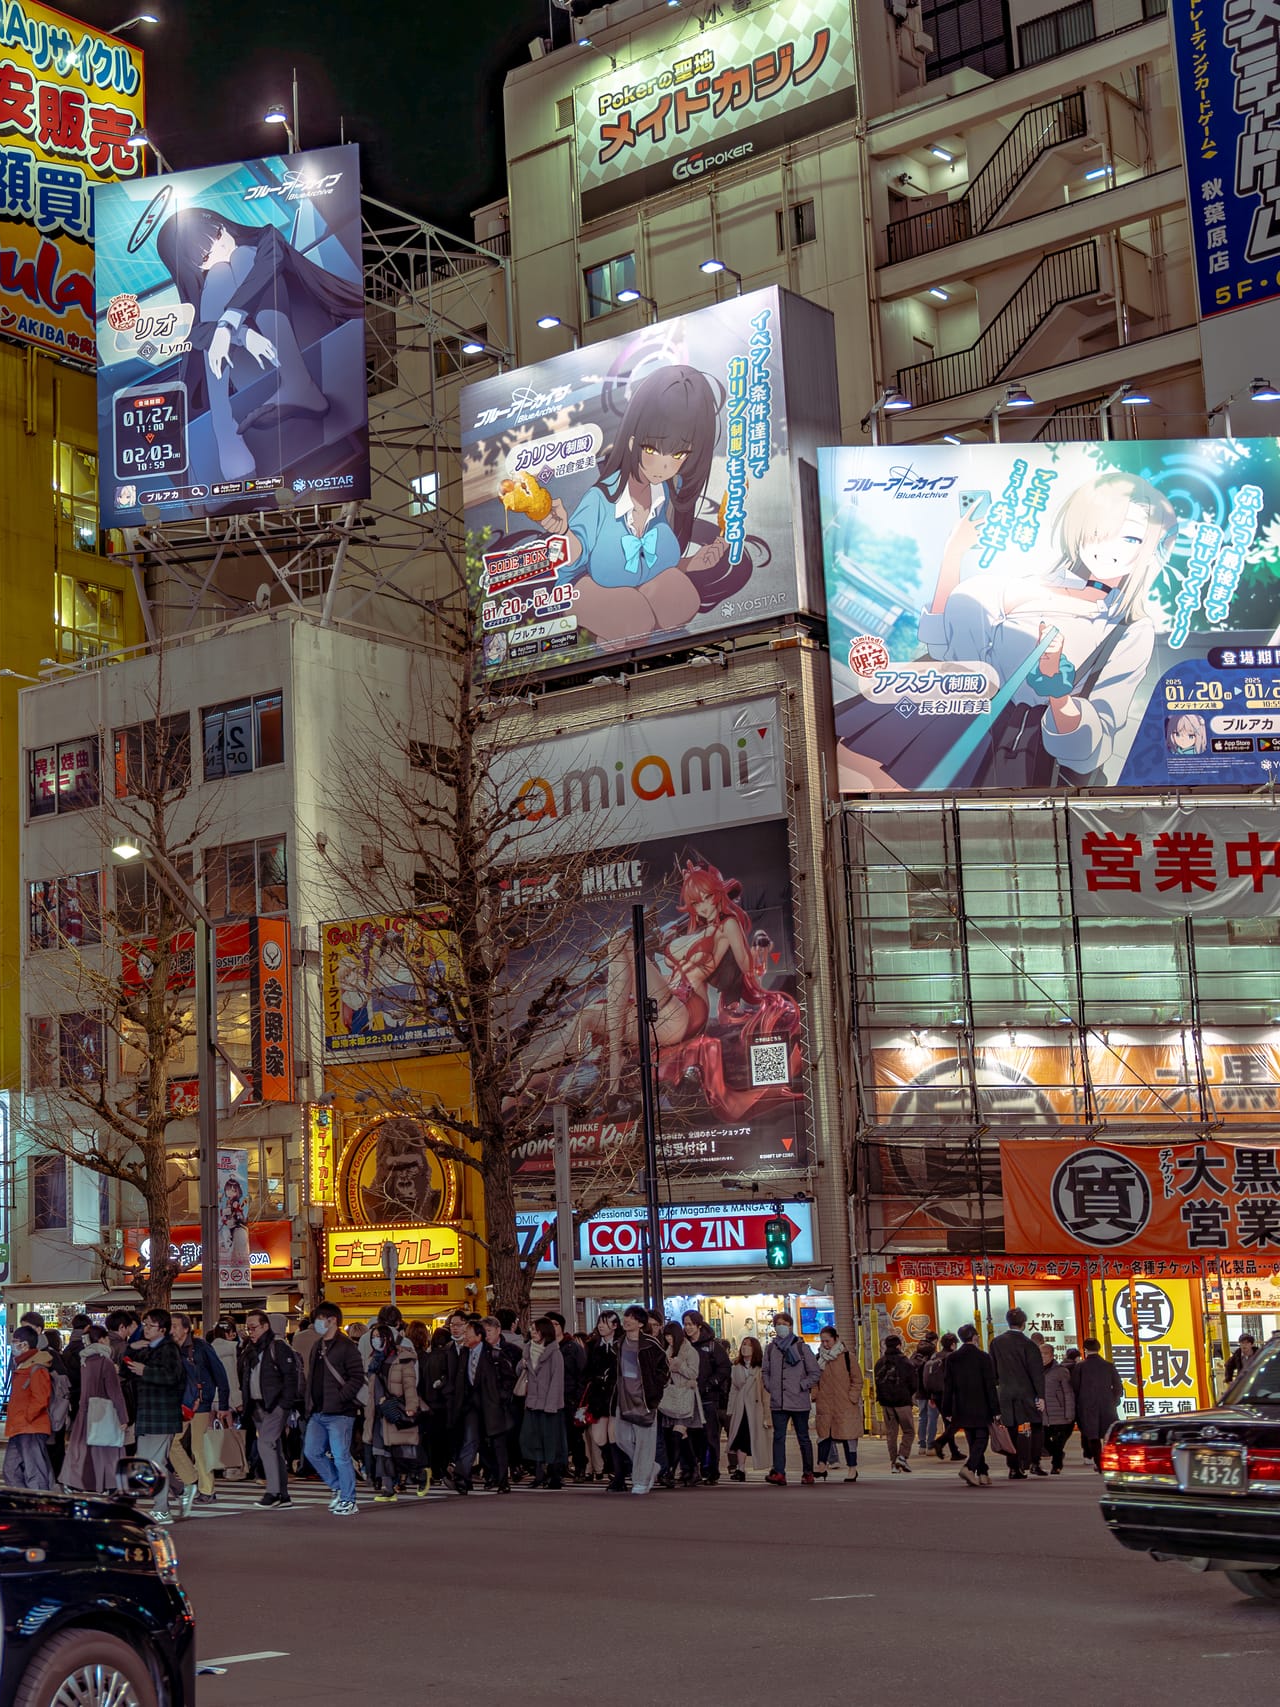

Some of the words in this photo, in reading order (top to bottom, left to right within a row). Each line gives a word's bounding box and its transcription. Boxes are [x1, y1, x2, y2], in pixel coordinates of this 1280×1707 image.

[599, 28, 831, 164] メイドカジノ
[244, 171, 342, 201] ブルーアーカイブ
[1201, 177, 1231, 275] 秋葉原店
[1215, 276, 1280, 305] 5F・
[110, 305, 140, 327] 限定
[135, 313, 177, 341] リオ
[159, 340, 191, 356] Lynn
[750, 308, 772, 478] イベント条件達成で
[474, 383, 572, 429] ブルーアーカイブ
[516, 434, 594, 471] カリン(制服)
[136, 460, 165, 472] 10:59
[307, 475, 354, 489] YOSTAR
[843, 473, 958, 493] ブルーアーカイブ
[146, 491, 179, 502] ブルアカ
[488, 555, 520, 575] CODE
[522, 548, 549, 566] BOX
[737, 592, 787, 613] YOSTAR
[851, 635, 884, 647] Limited!
[852, 649, 887, 670] 限定
[873, 672, 988, 695] アスナ(制服)
[1165, 681, 1223, 701] 01/20
[919, 700, 991, 717] 長谷川育美
[1223, 719, 1273, 731] ブルアカ
[1224, 740, 1236, 748] App
[517, 737, 750, 822] amiami
[1081, 831, 1280, 895] 営業中
[581, 859, 643, 896] NIKKE
[328, 951, 340, 1033] カレーライフ！
[263, 976, 285, 1078] 吉野家
[1159, 1148, 1176, 1200] チケット
[1065, 1163, 1137, 1234] 質
[681, 1204, 721, 1217] Magazine
[723, 1204, 729, 1213] &
[701, 1219, 746, 1249] ZIN
[899, 1260, 965, 1278] 高価買取
[882, 1282, 892, 1296] &
[895, 1278, 932, 1297] 買取
[1119, 1289, 1166, 1334] 質
[1026, 1319, 1066, 1333] 大黒屋
[1112, 1345, 1194, 1388] 買取
[1122, 1400, 1194, 1415] 個室完備
[1200, 1466, 1241, 1486] 43-26
